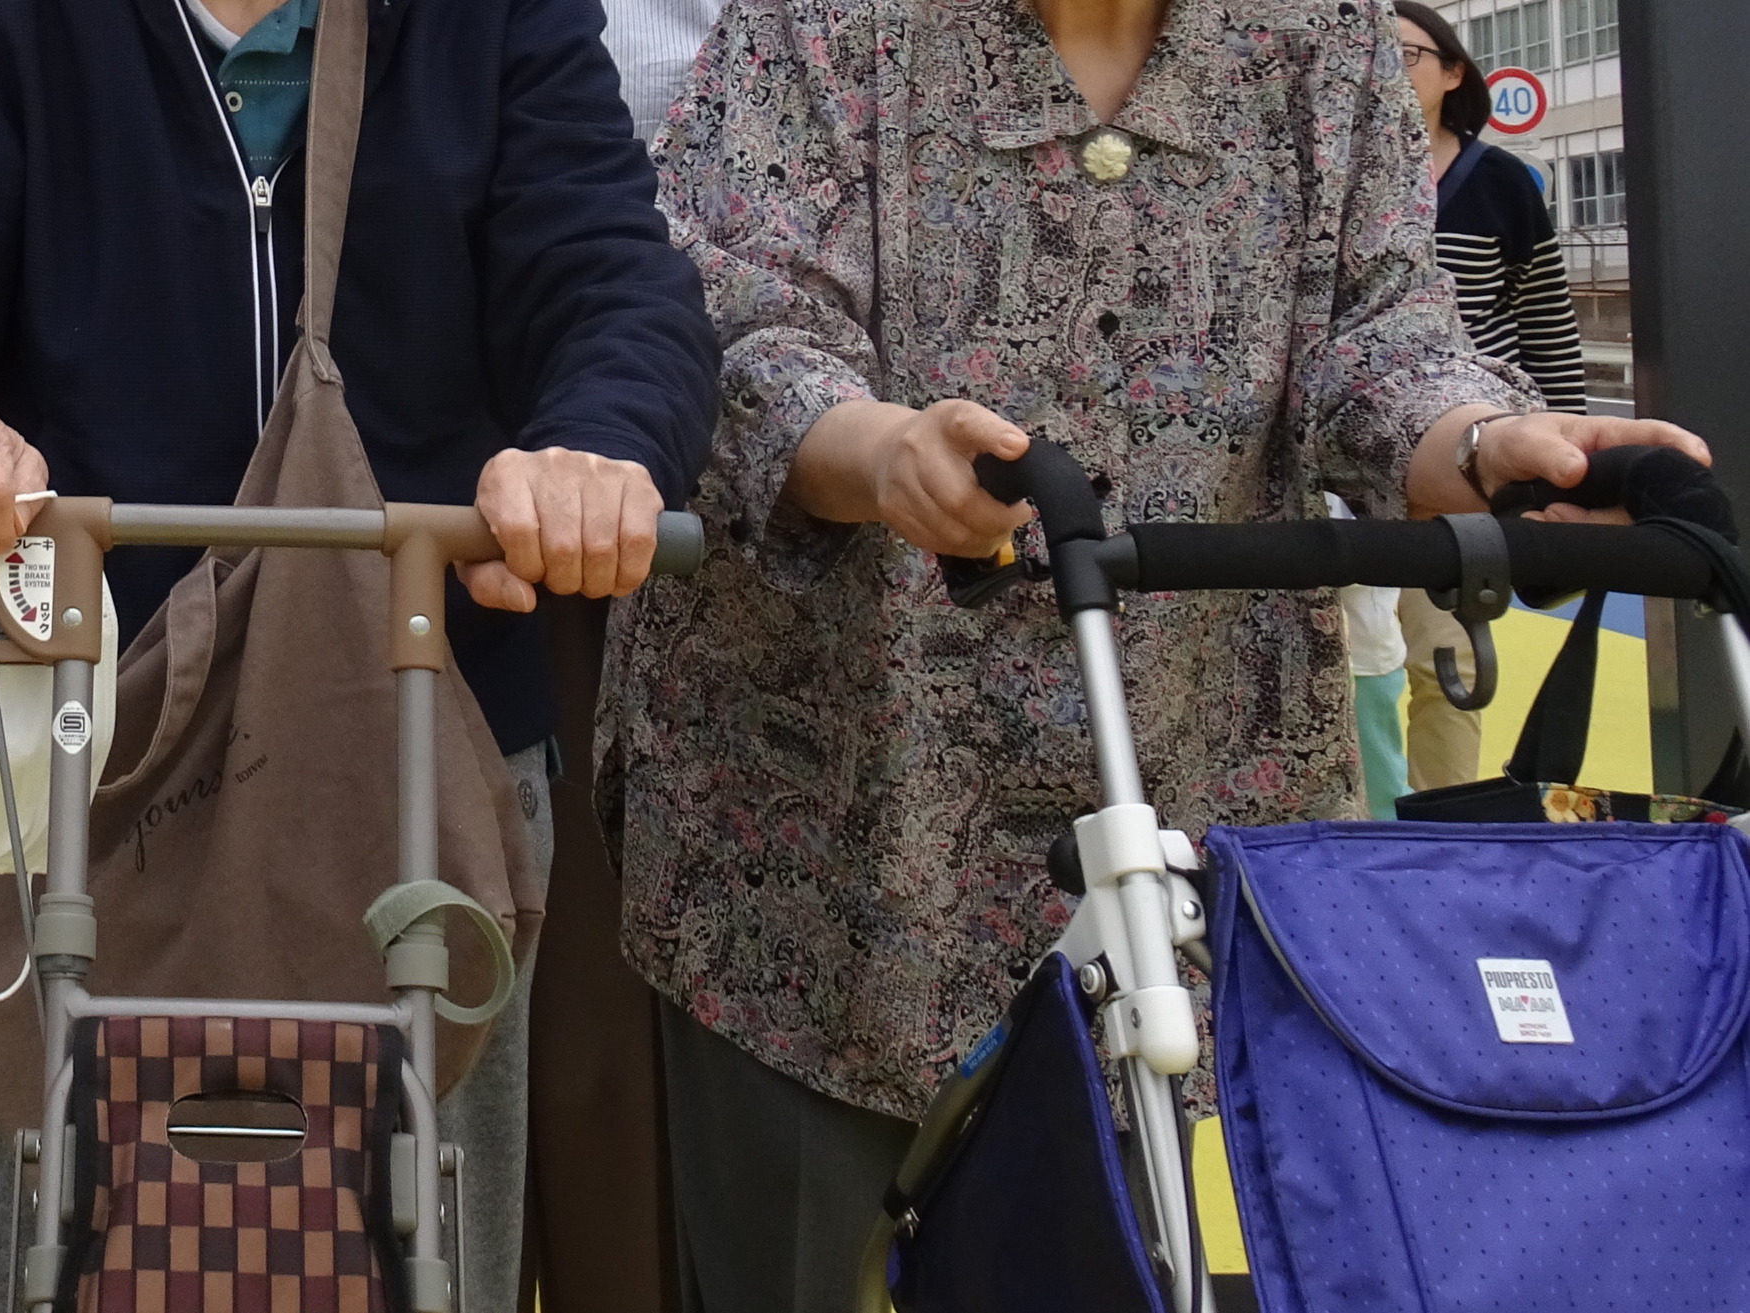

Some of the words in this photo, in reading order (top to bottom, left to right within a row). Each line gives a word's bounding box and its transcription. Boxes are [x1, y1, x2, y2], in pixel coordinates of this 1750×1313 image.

[1495, 87, 1532, 116] 40
[24, 572, 51, 580] BRAKE
[24, 580, 51, 588] SYSTEM
[39, 602, 51, 634] ロック
[1484, 971, 1553, 990] PIUPRESTO
